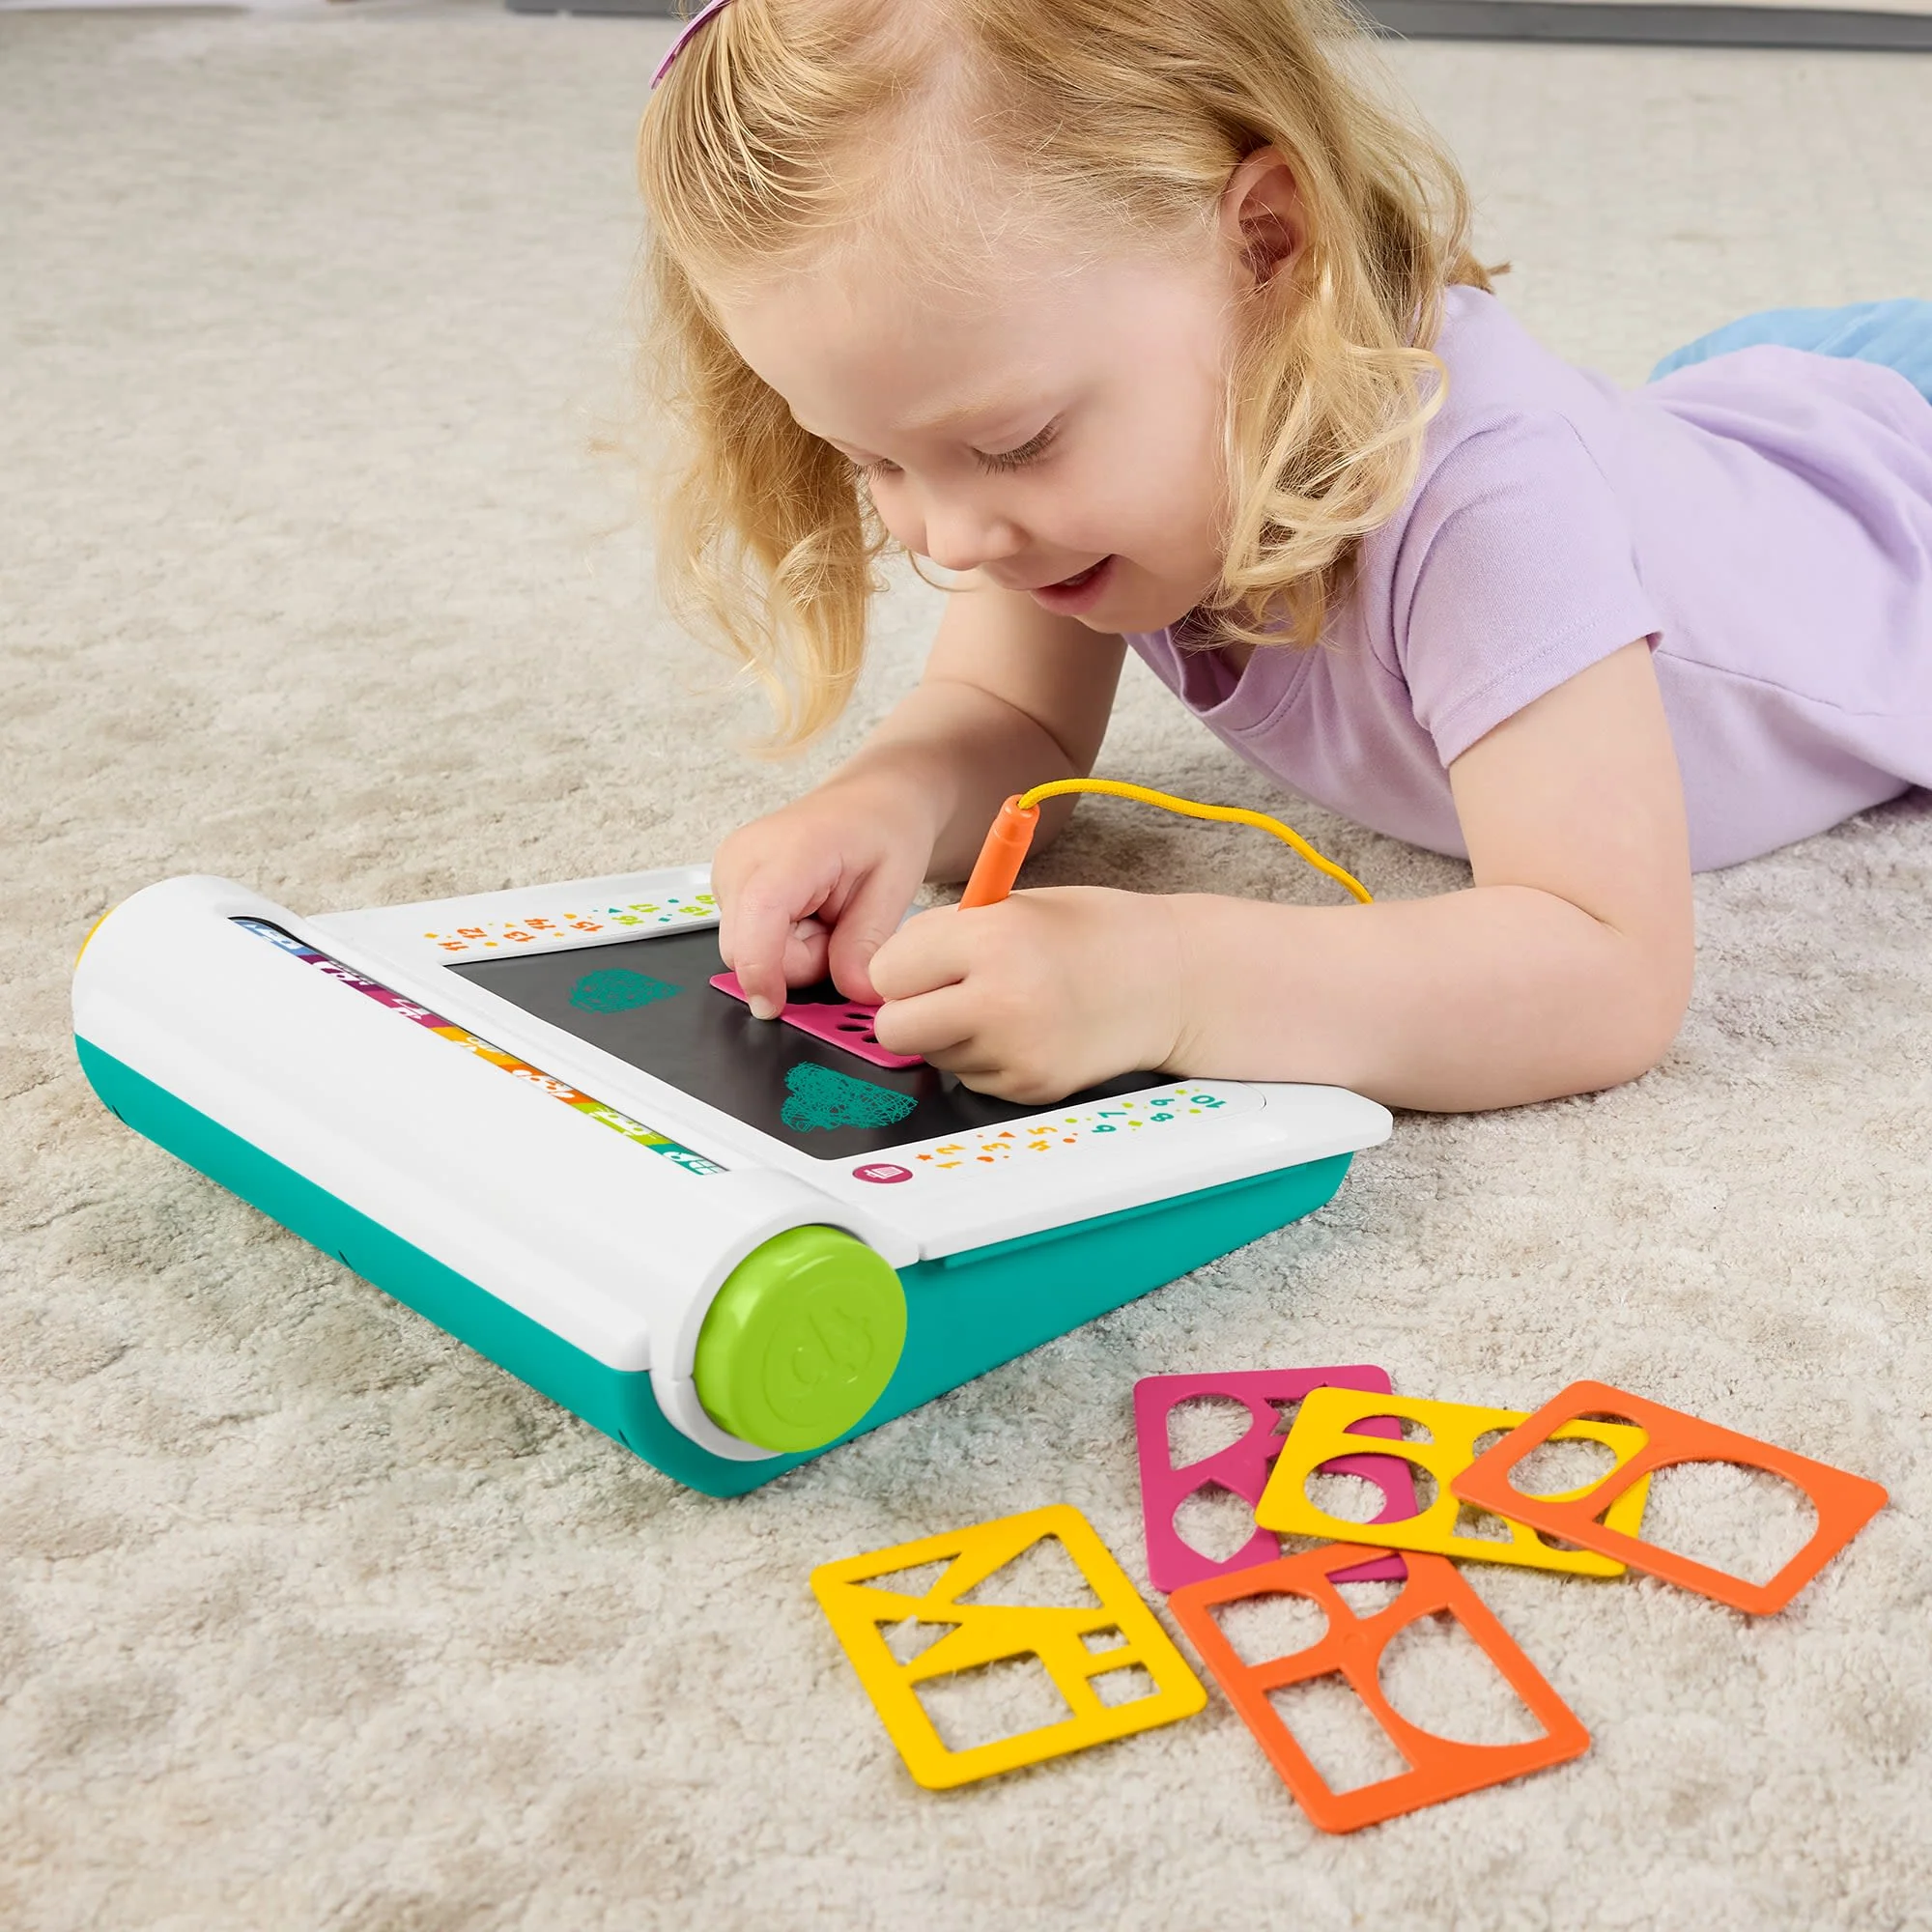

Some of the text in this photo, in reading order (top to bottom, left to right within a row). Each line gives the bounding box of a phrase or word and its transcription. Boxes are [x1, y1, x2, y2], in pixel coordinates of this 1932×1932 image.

[627, 903, 661, 913] 17
[524, 918, 557, 930] 14
[569, 921, 604, 932] 15
[456, 927, 488, 939] 12
[502, 930, 537, 943] 13
[438, 941, 469, 952] 11
[1150, 1098, 1175, 1107] 9
[1190, 1094, 1227, 1109] 10
[1150, 1112, 1175, 1122] 8
[1027, 1125, 1058, 1135] 5
[1091, 1124, 1117, 1133] 6
[935, 1143, 966, 1154] 2
[980, 1142, 1011, 1152] 3
[1027, 1140, 1051, 1151] 4
[935, 1160, 963, 1169] 1
